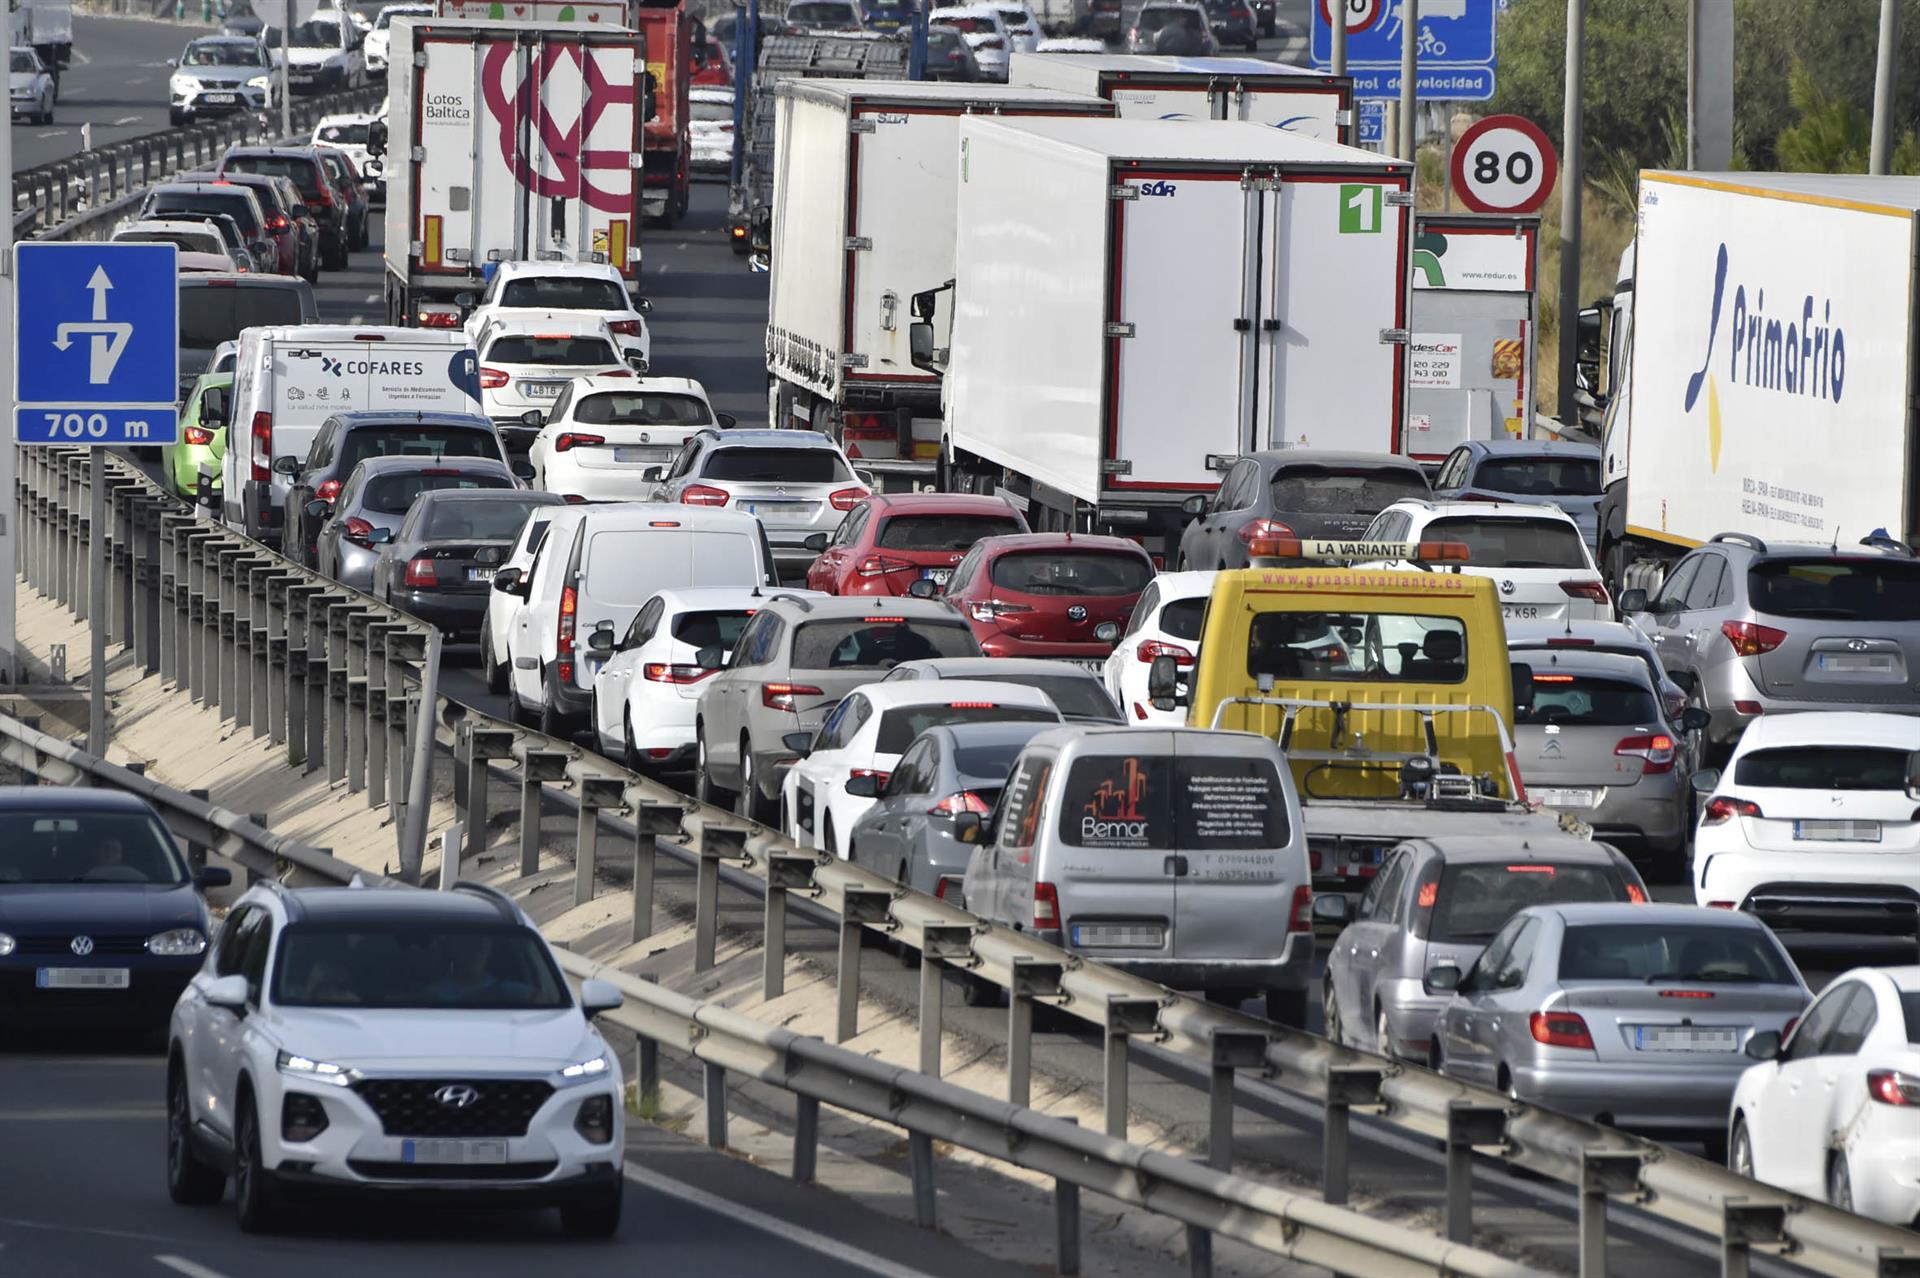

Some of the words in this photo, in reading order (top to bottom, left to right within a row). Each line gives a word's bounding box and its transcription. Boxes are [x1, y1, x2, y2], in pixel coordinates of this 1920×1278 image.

[1353, 77, 1379, 89] trol
[427, 93, 462, 105] Lotos
[426, 106, 470, 119] Baltica
[1474, 150, 1533, 184] 80
[1348, 188, 1374, 231] 1
[1462, 272, 1518, 281] www.redur.es
[347, 361, 423, 376] COFARES
[44, 413, 108, 438] 700
[124, 420, 149, 438] m
[1317, 543, 1335, 555] LA
[1339, 543, 1407, 557] VARIANTE
[1262, 572, 1463, 590] www.gruaslavariante.es
[1082, 816, 1149, 838] Bemar
